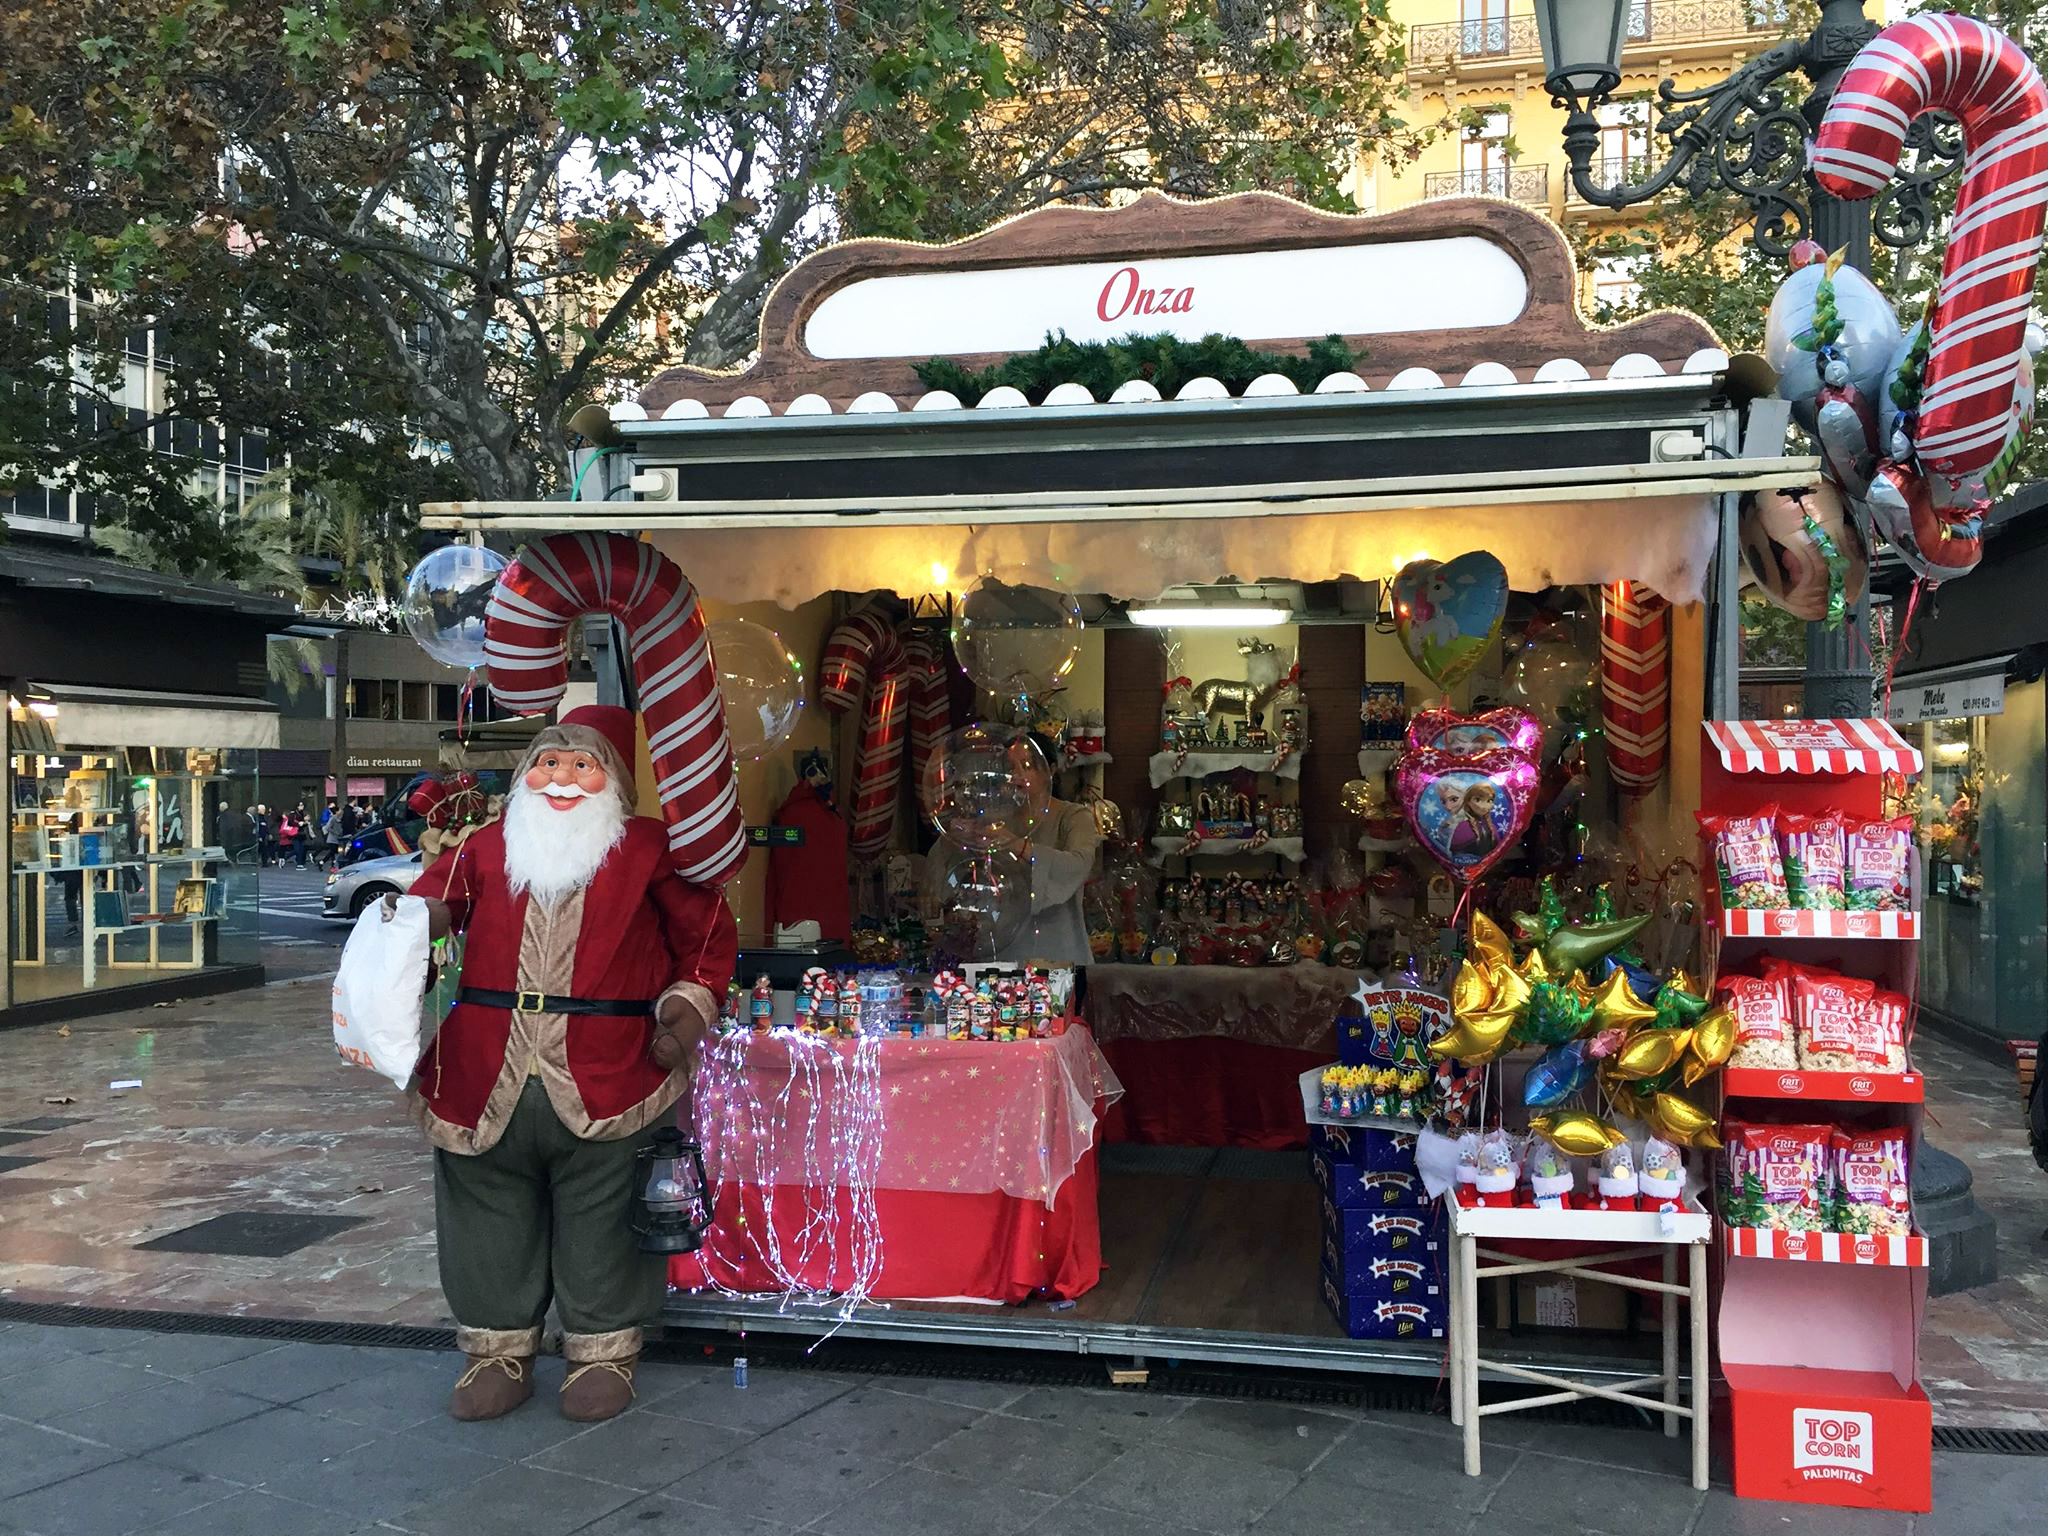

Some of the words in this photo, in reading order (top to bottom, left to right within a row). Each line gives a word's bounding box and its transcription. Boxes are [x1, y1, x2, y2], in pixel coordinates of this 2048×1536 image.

[1097, 267, 1195, 322] Onza
[346, 756, 369, 767] dian
[372, 757, 422, 767] restaurant
[1729, 817, 1752, 829] FRIT
[1863, 825, 1889, 835] FRIT
[1731, 843, 1762, 857] TOP
[1814, 847, 1835, 859] TO
[1861, 850, 1893, 863] TOP
[1861, 863, 1893, 871] CORN
[1777, 916, 1796, 925] FRIT
[1363, 991, 1402, 1007] REYES
[1405, 991, 1449, 1015] MAGOS
[1743, 1002, 1773, 1013] TOP
[1743, 1013, 1773, 1022] CORN
[1819, 1012, 1849, 1025] TOP
[1746, 1029, 1773, 1038] SALADAS
[1857, 1023, 1878, 1036] OP
[1781, 1078, 1800, 1087] FRIT
[1852, 1081, 1872, 1090] FRIT
[1774, 1139, 1799, 1149] FRIT
[1852, 1140, 1875, 1150] FRIT
[1772, 1166, 1802, 1178] TOP
[1851, 1164, 1882, 1177] TOP
[1772, 1177, 1801, 1187] CORN
[1851, 1176, 1882, 1186] CORN
[1785, 1239, 1805, 1249] FRIT
[1856, 1243, 1876, 1253] FRIT
[1804, 1418, 1861, 1442] TOP
[1804, 1440, 1861, 1459] CORN
[1802, 1467, 1864, 1484] PALOMITAS
